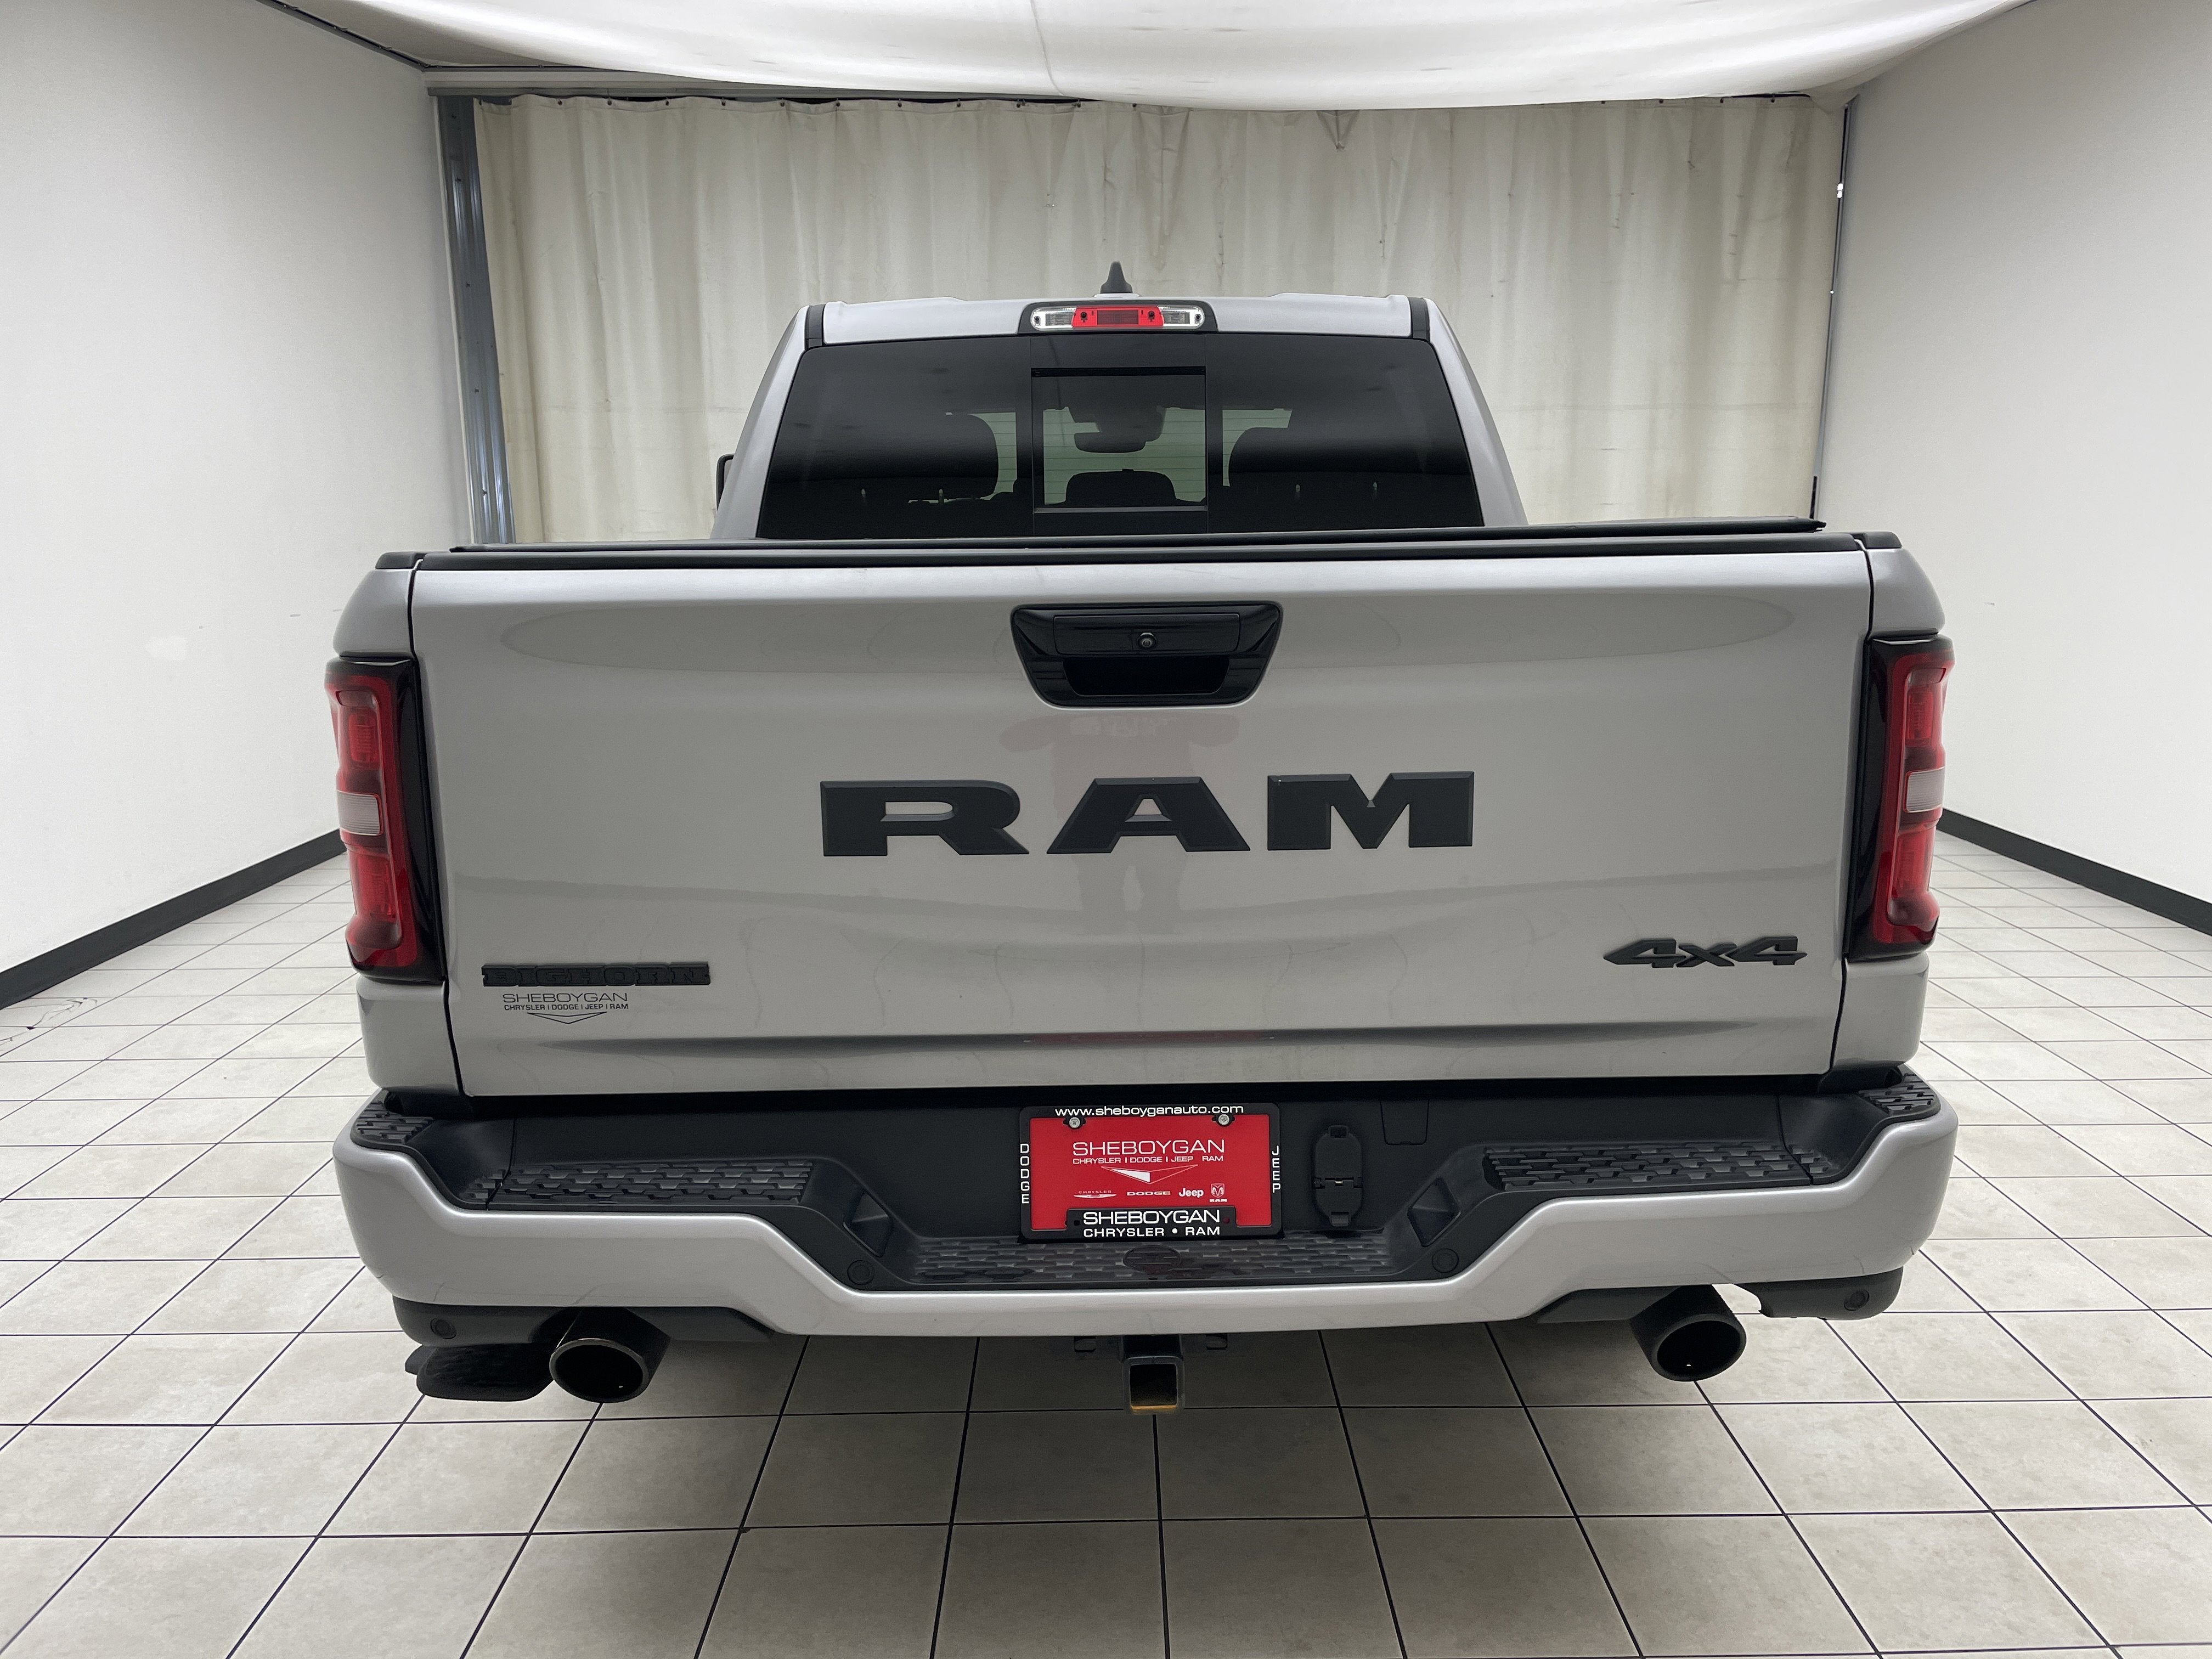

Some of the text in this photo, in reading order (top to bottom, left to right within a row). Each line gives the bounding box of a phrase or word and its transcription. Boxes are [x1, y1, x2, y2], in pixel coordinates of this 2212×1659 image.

[820, 771, 1474, 856] RAM
[503, 992, 627, 1002] SHEBOYGAN
[1054, 1104, 1244, 1118] www.sheboyganauto.com
[1073, 1139, 1224, 1156] SHEBOYGAN
[1020, 1143, 1030, 1204] DODGE
[1272, 1146, 1280, 1193] JEEP
[1178, 1188, 1204, 1198] Jeep
[1083, 1210, 1220, 1225] SHEBOYGAN
[1084, 1227, 1220, 1237] CHRYSLER RAM
